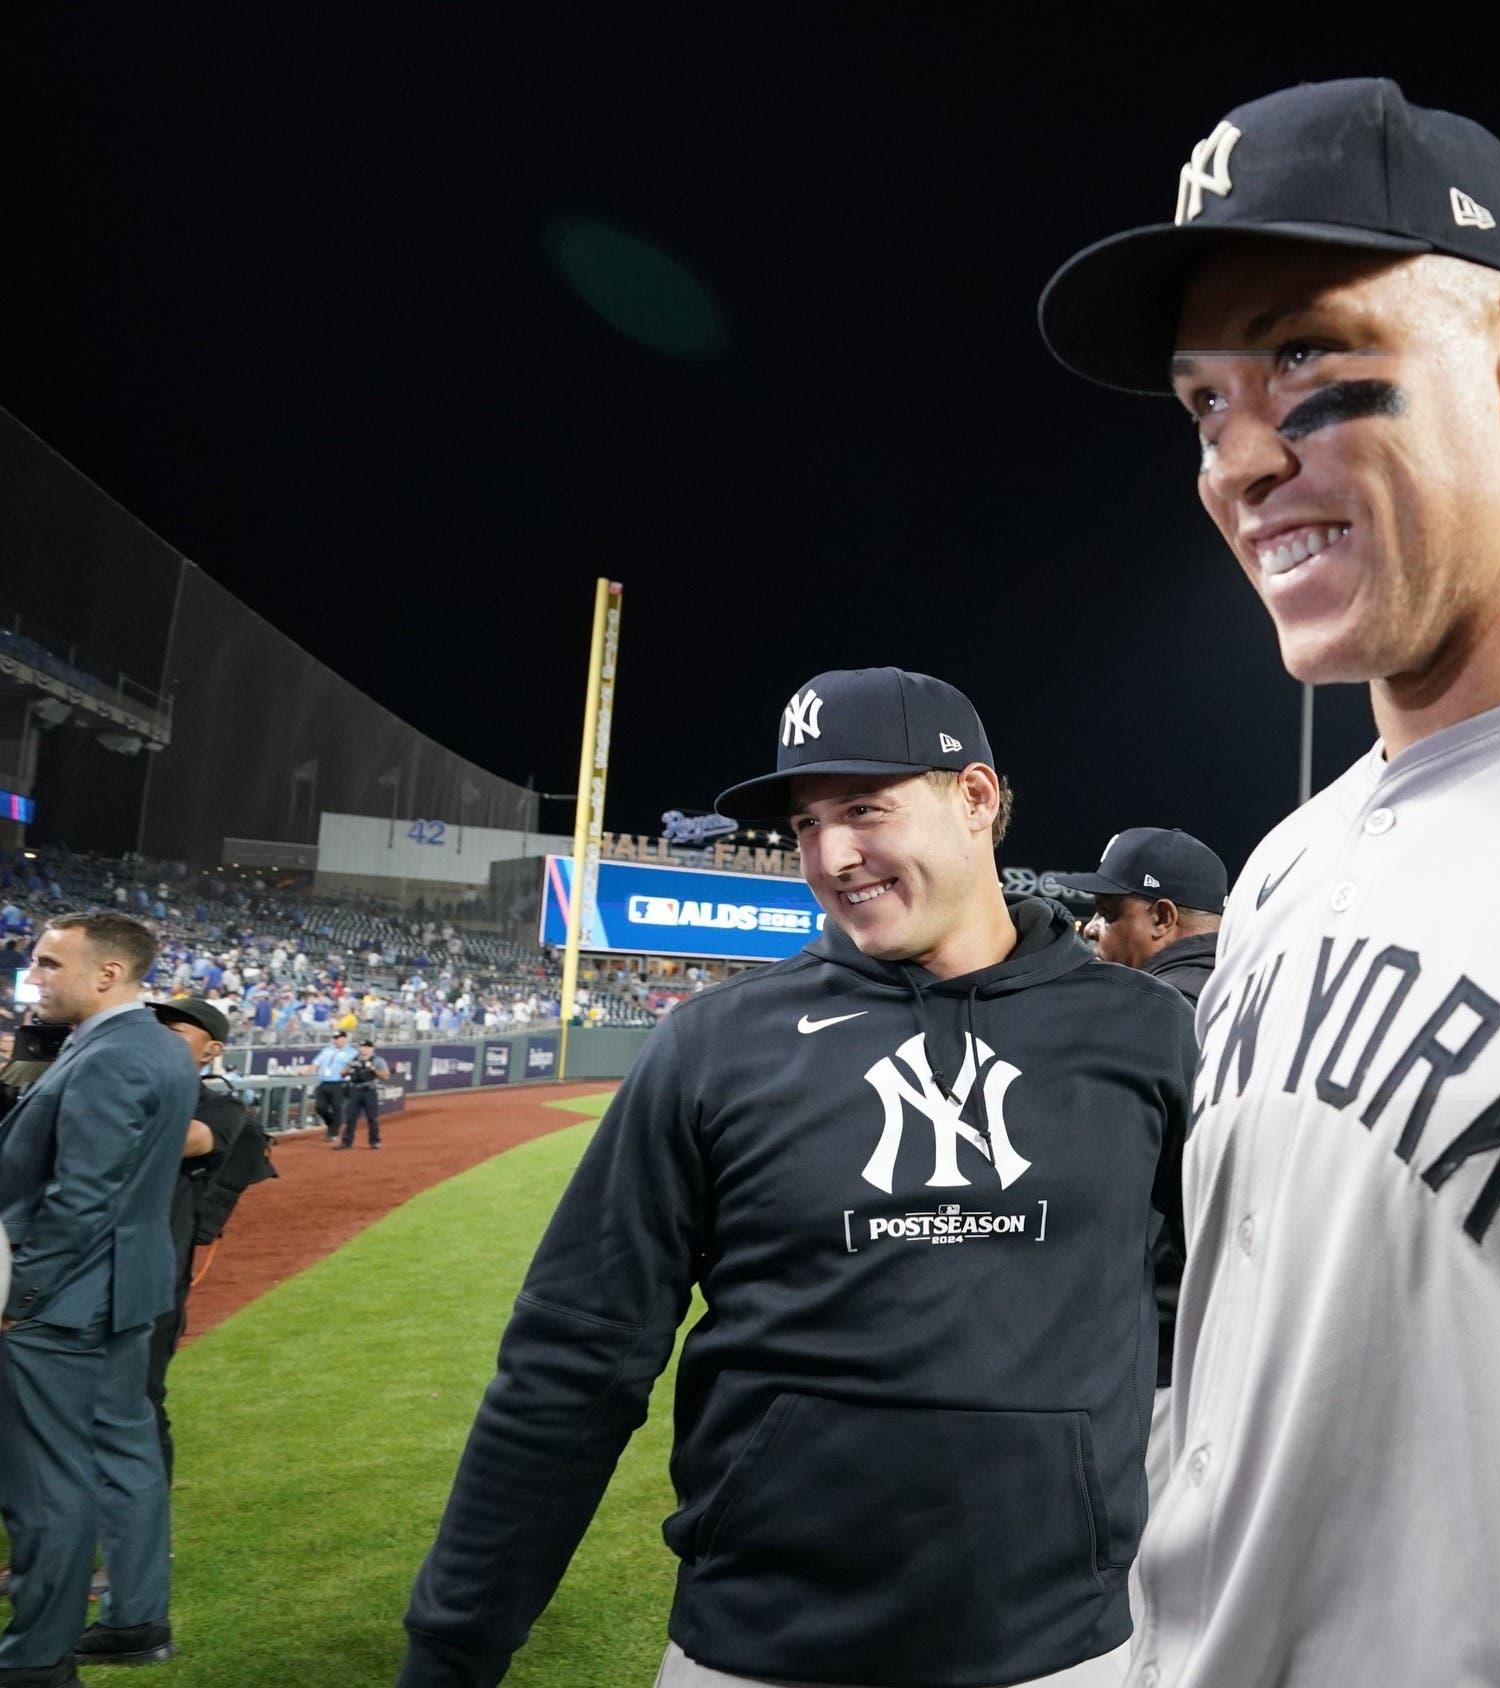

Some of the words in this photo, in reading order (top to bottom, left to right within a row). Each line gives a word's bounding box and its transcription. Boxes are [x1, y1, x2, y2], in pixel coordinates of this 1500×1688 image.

[1174, 119, 1242, 227] NY
[781, 688, 824, 748] NY
[407, 817, 446, 845] 42
[678, 900, 759, 931] ALDS
[860, 1031, 1033, 1195] NY
[868, 1214, 1026, 1240] POSTSEASON
[931, 1234, 964, 1245] 2024
